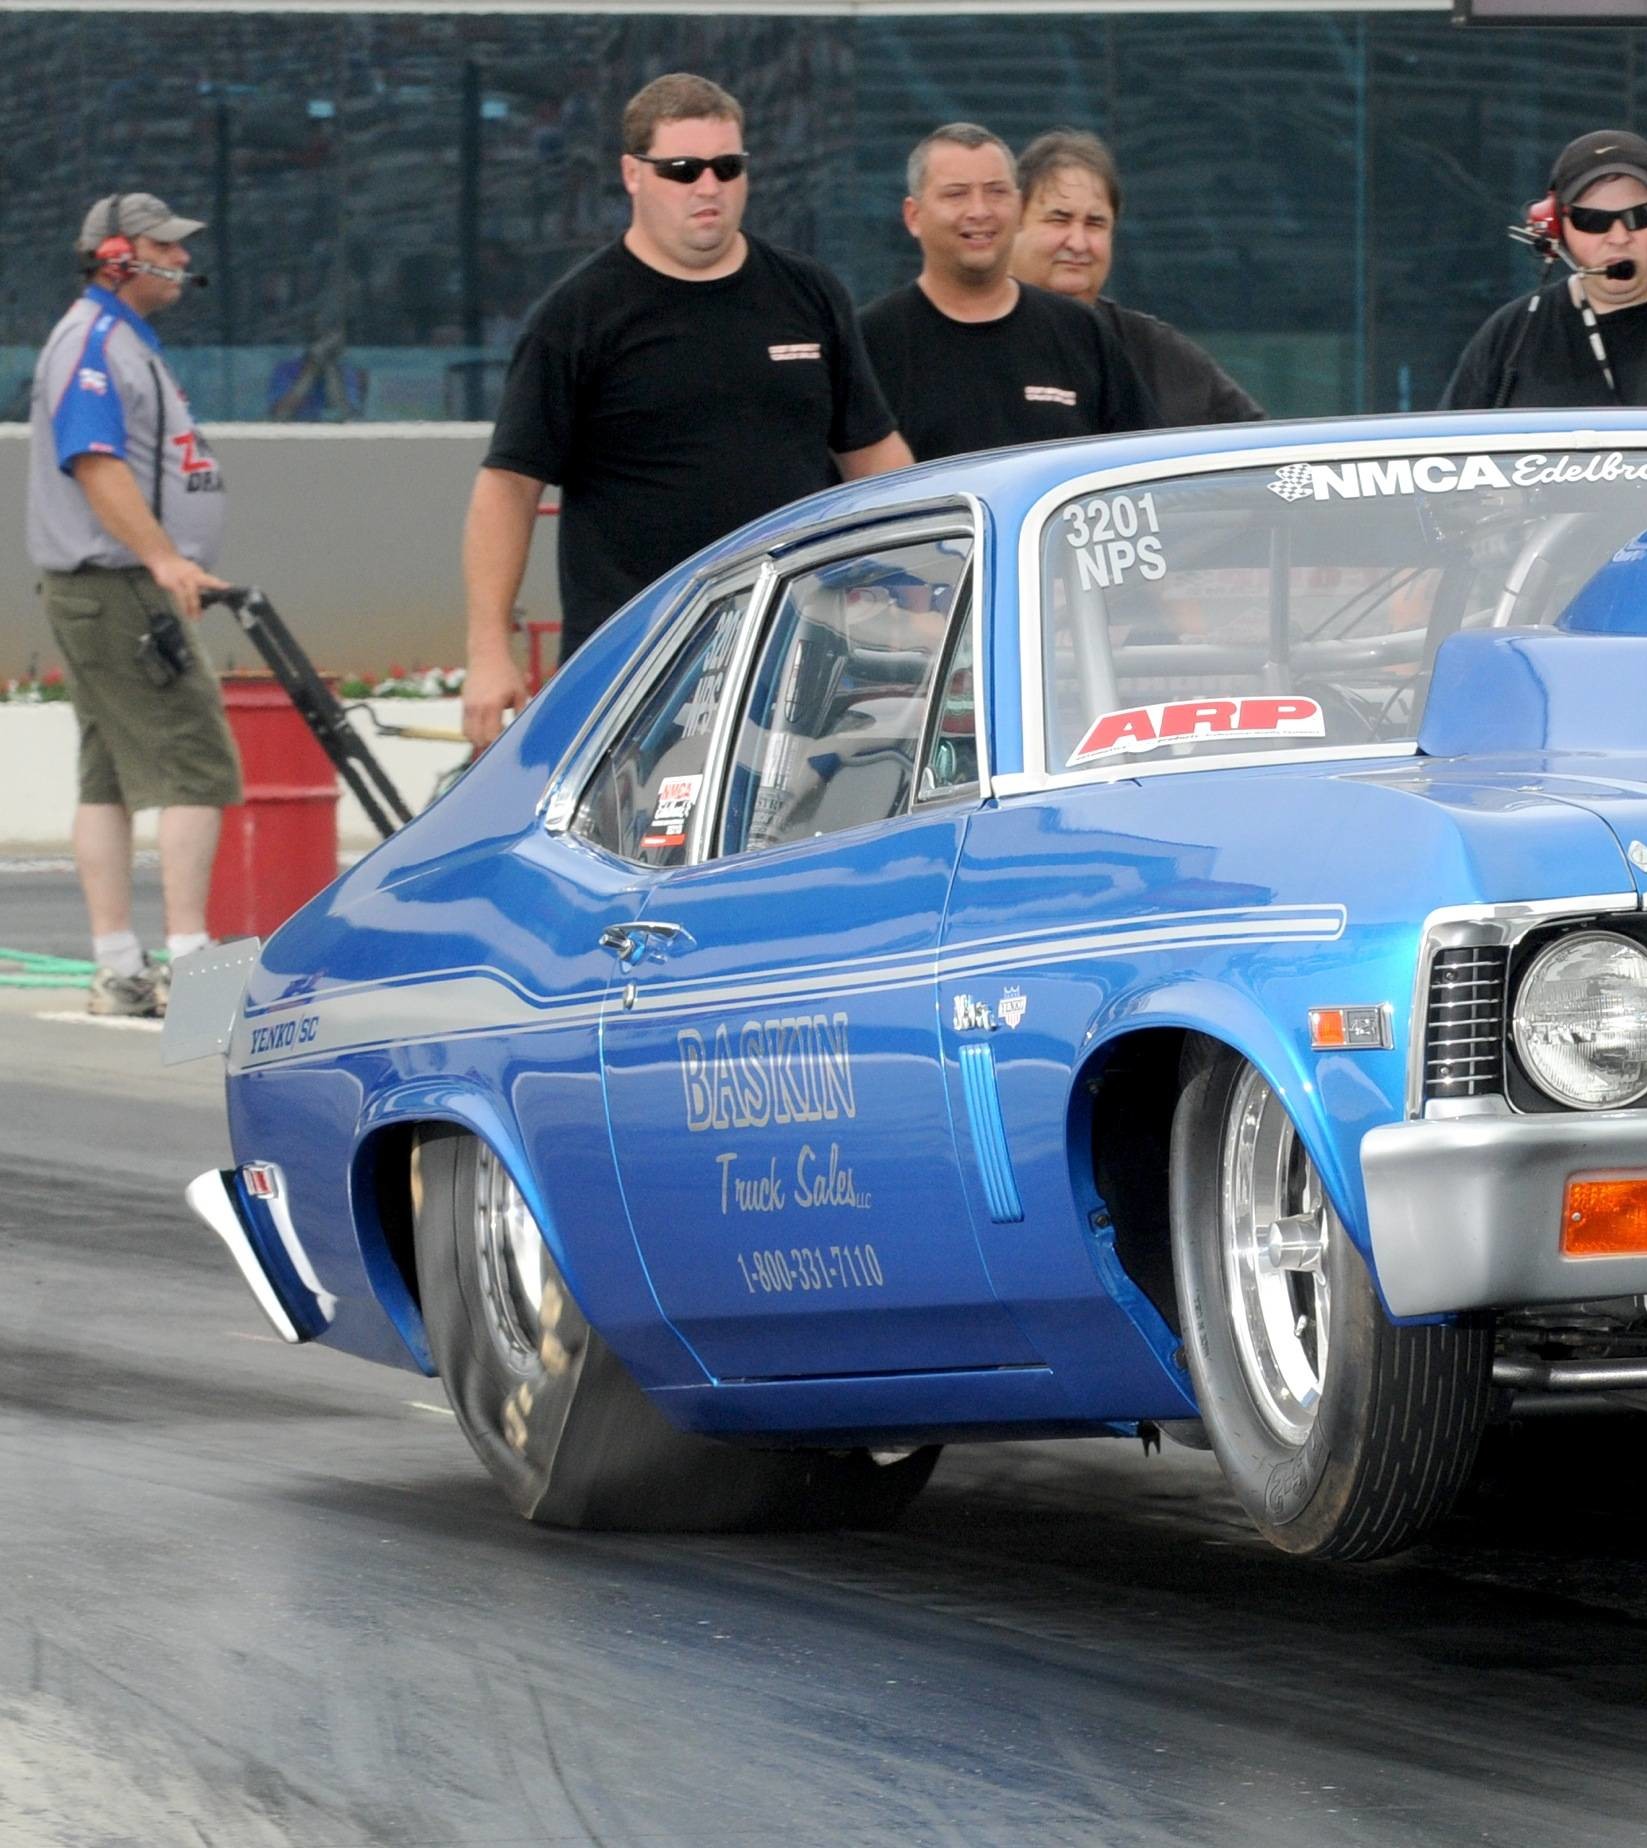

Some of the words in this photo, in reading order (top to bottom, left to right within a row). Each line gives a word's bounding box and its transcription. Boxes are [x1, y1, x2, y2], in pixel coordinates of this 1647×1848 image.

[1312, 454, 1511, 501] NMCA
[1063, 492, 1160, 548] 3201
[1076, 536, 1167, 591] NPS
[1077, 699, 1317, 756] ARP
[677, 1012, 856, 1132] BASKIN
[715, 1152, 785, 1215] Truck
[794, 1142, 856, 1207] Sales
[737, 1244, 884, 1294] 1-800-331-7110
